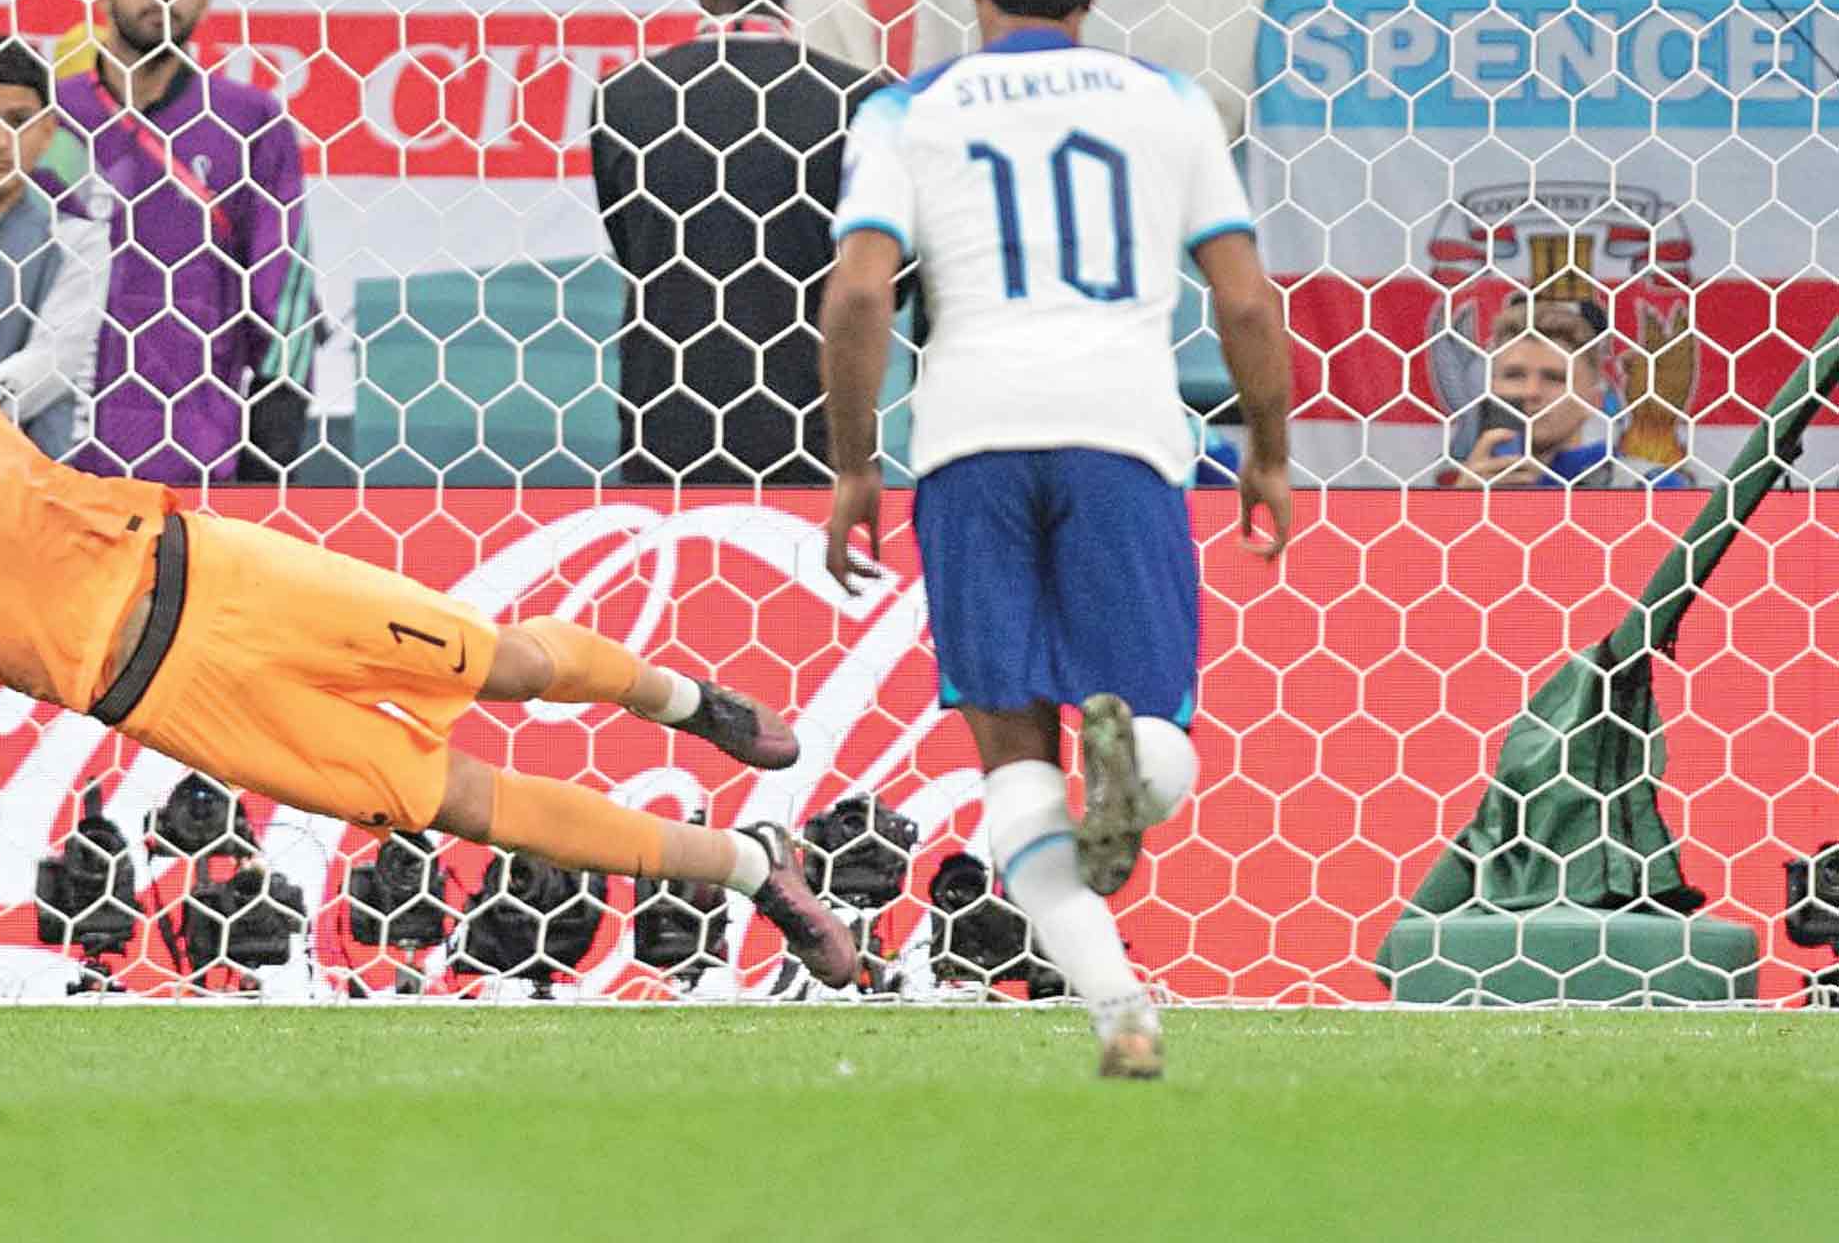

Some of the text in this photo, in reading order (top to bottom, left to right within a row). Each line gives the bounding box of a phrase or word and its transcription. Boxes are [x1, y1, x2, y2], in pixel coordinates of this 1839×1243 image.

[363, 41, 680, 152] CIT
[956, 67, 1126, 107] STERLING
[967, 128, 1139, 301] 10
[386, 621, 447, 648] 1
